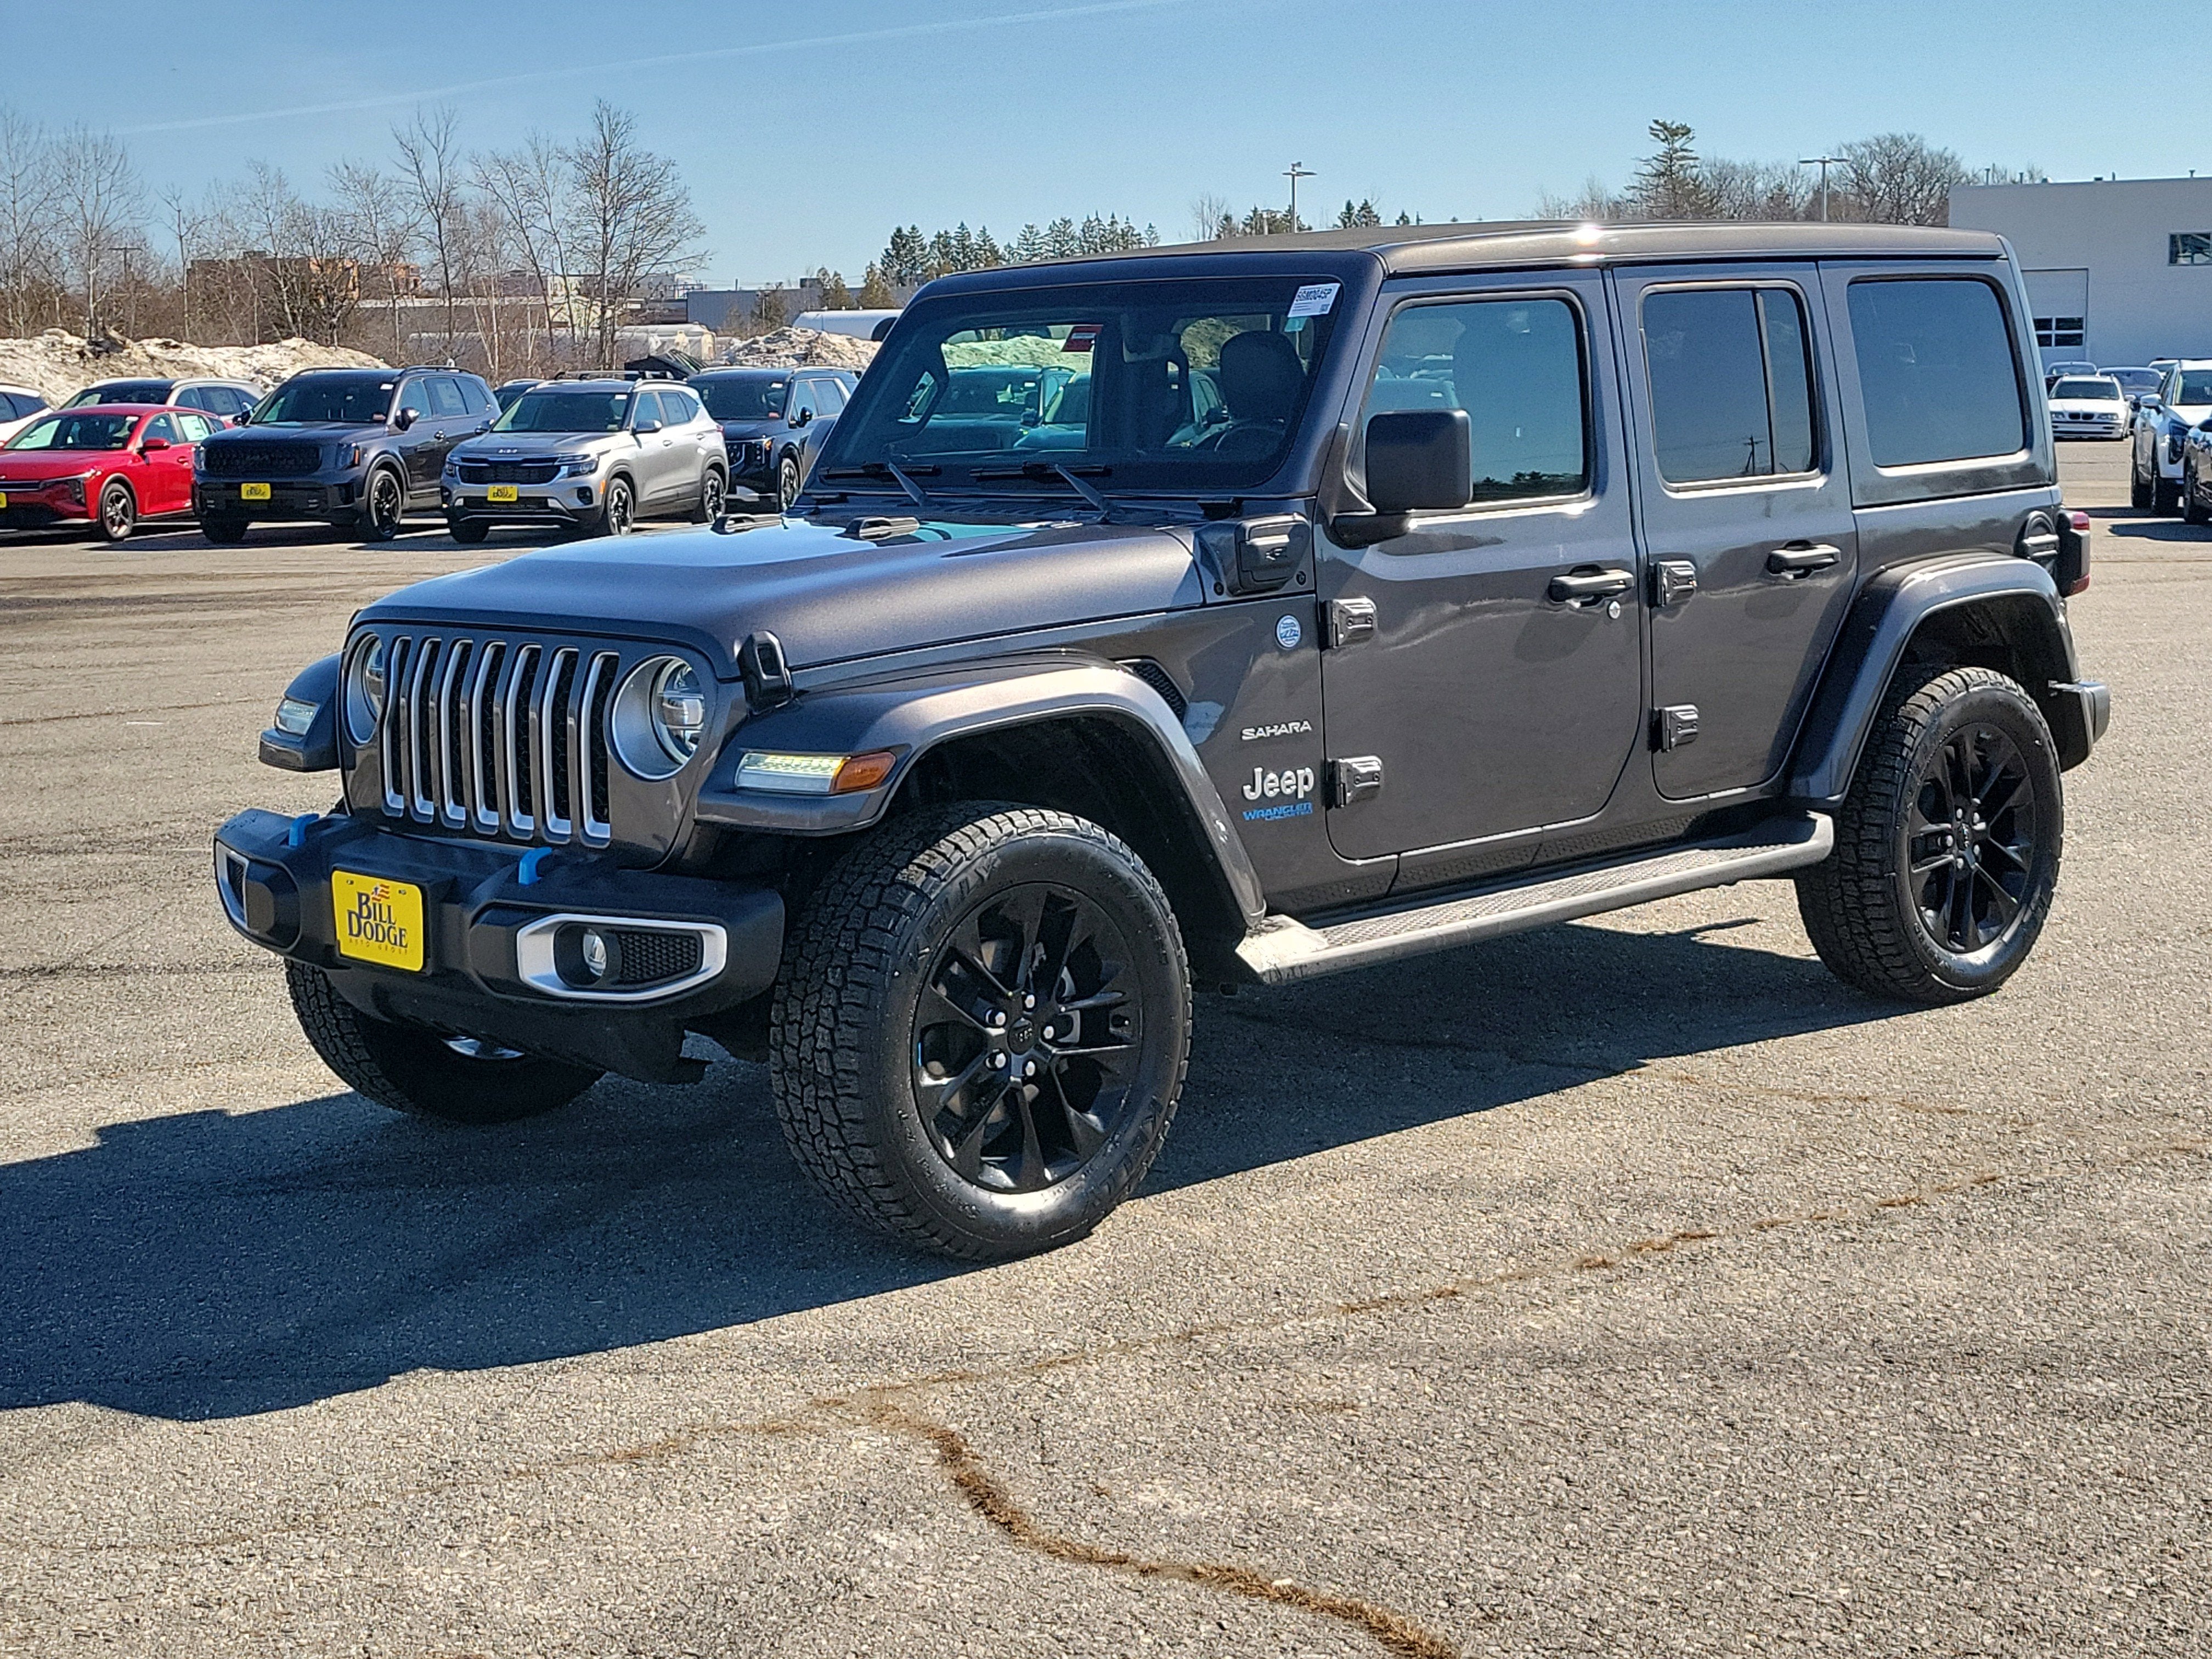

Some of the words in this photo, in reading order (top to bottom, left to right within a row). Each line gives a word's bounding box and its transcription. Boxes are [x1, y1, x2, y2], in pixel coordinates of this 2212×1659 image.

[1242, 720, 1312, 740] SAHARA
[1243, 767, 1314, 800] Jeep
[1242, 802, 1312, 820] WRANGLER
[357, 891, 397, 925] BILL
[347, 909, 408, 948] DODGE
